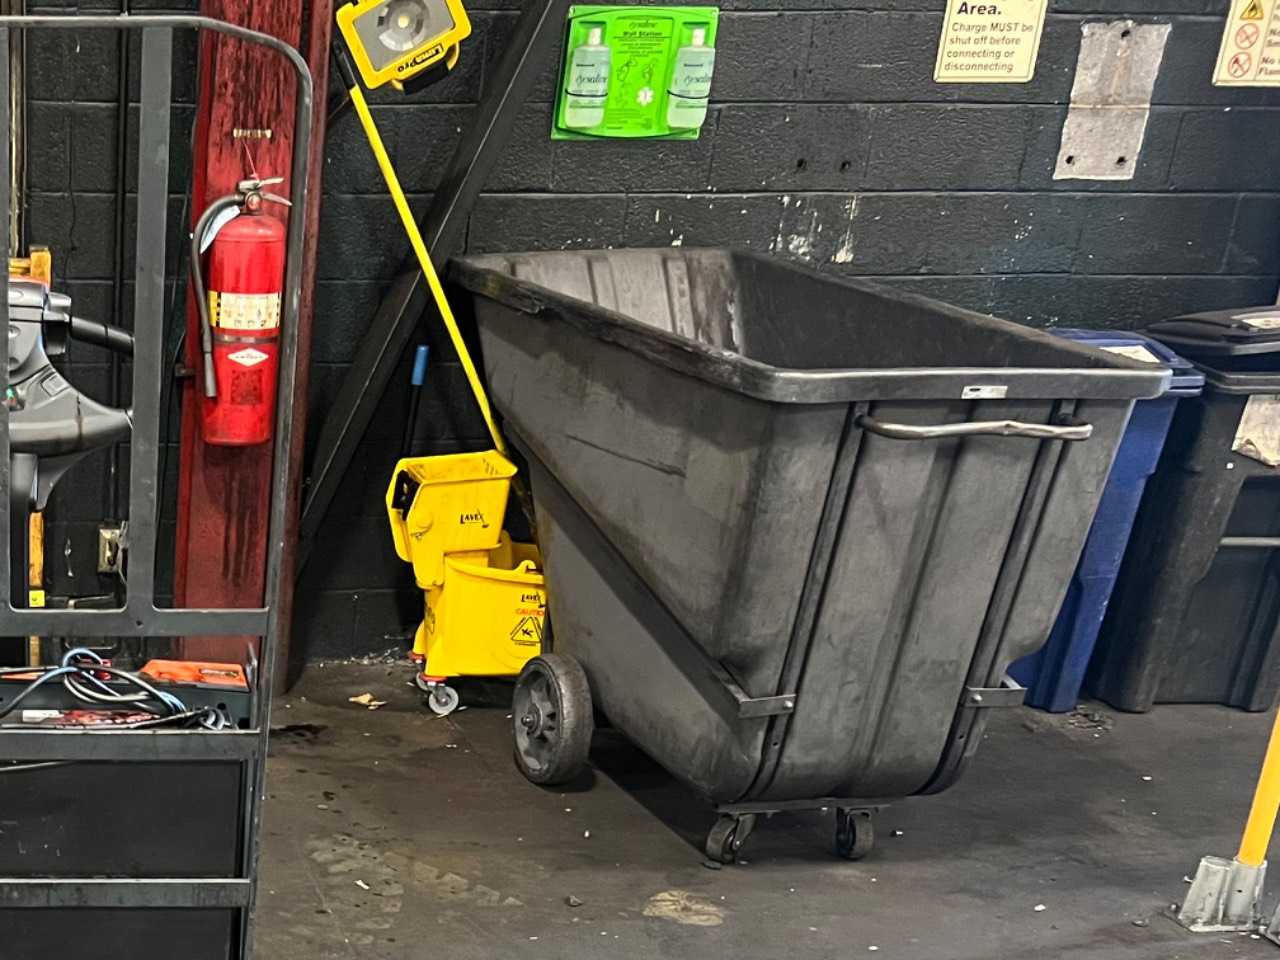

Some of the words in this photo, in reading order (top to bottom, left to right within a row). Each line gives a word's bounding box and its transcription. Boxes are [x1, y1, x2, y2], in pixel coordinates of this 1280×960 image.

[957, 1, 1002, 15] Area.
[951, 22, 987, 33] Charge
[989, 22, 1020, 32] MUST
[1021, 22, 1034, 32] be
[949, 35, 971, 45] shut
[973, 35, 988, 45] off
[989, 35, 1022, 45] before
[946, 49, 1002, 59] connecting
[1004, 50, 1016, 58] or
[944, 62, 1014, 73] disconnecting
